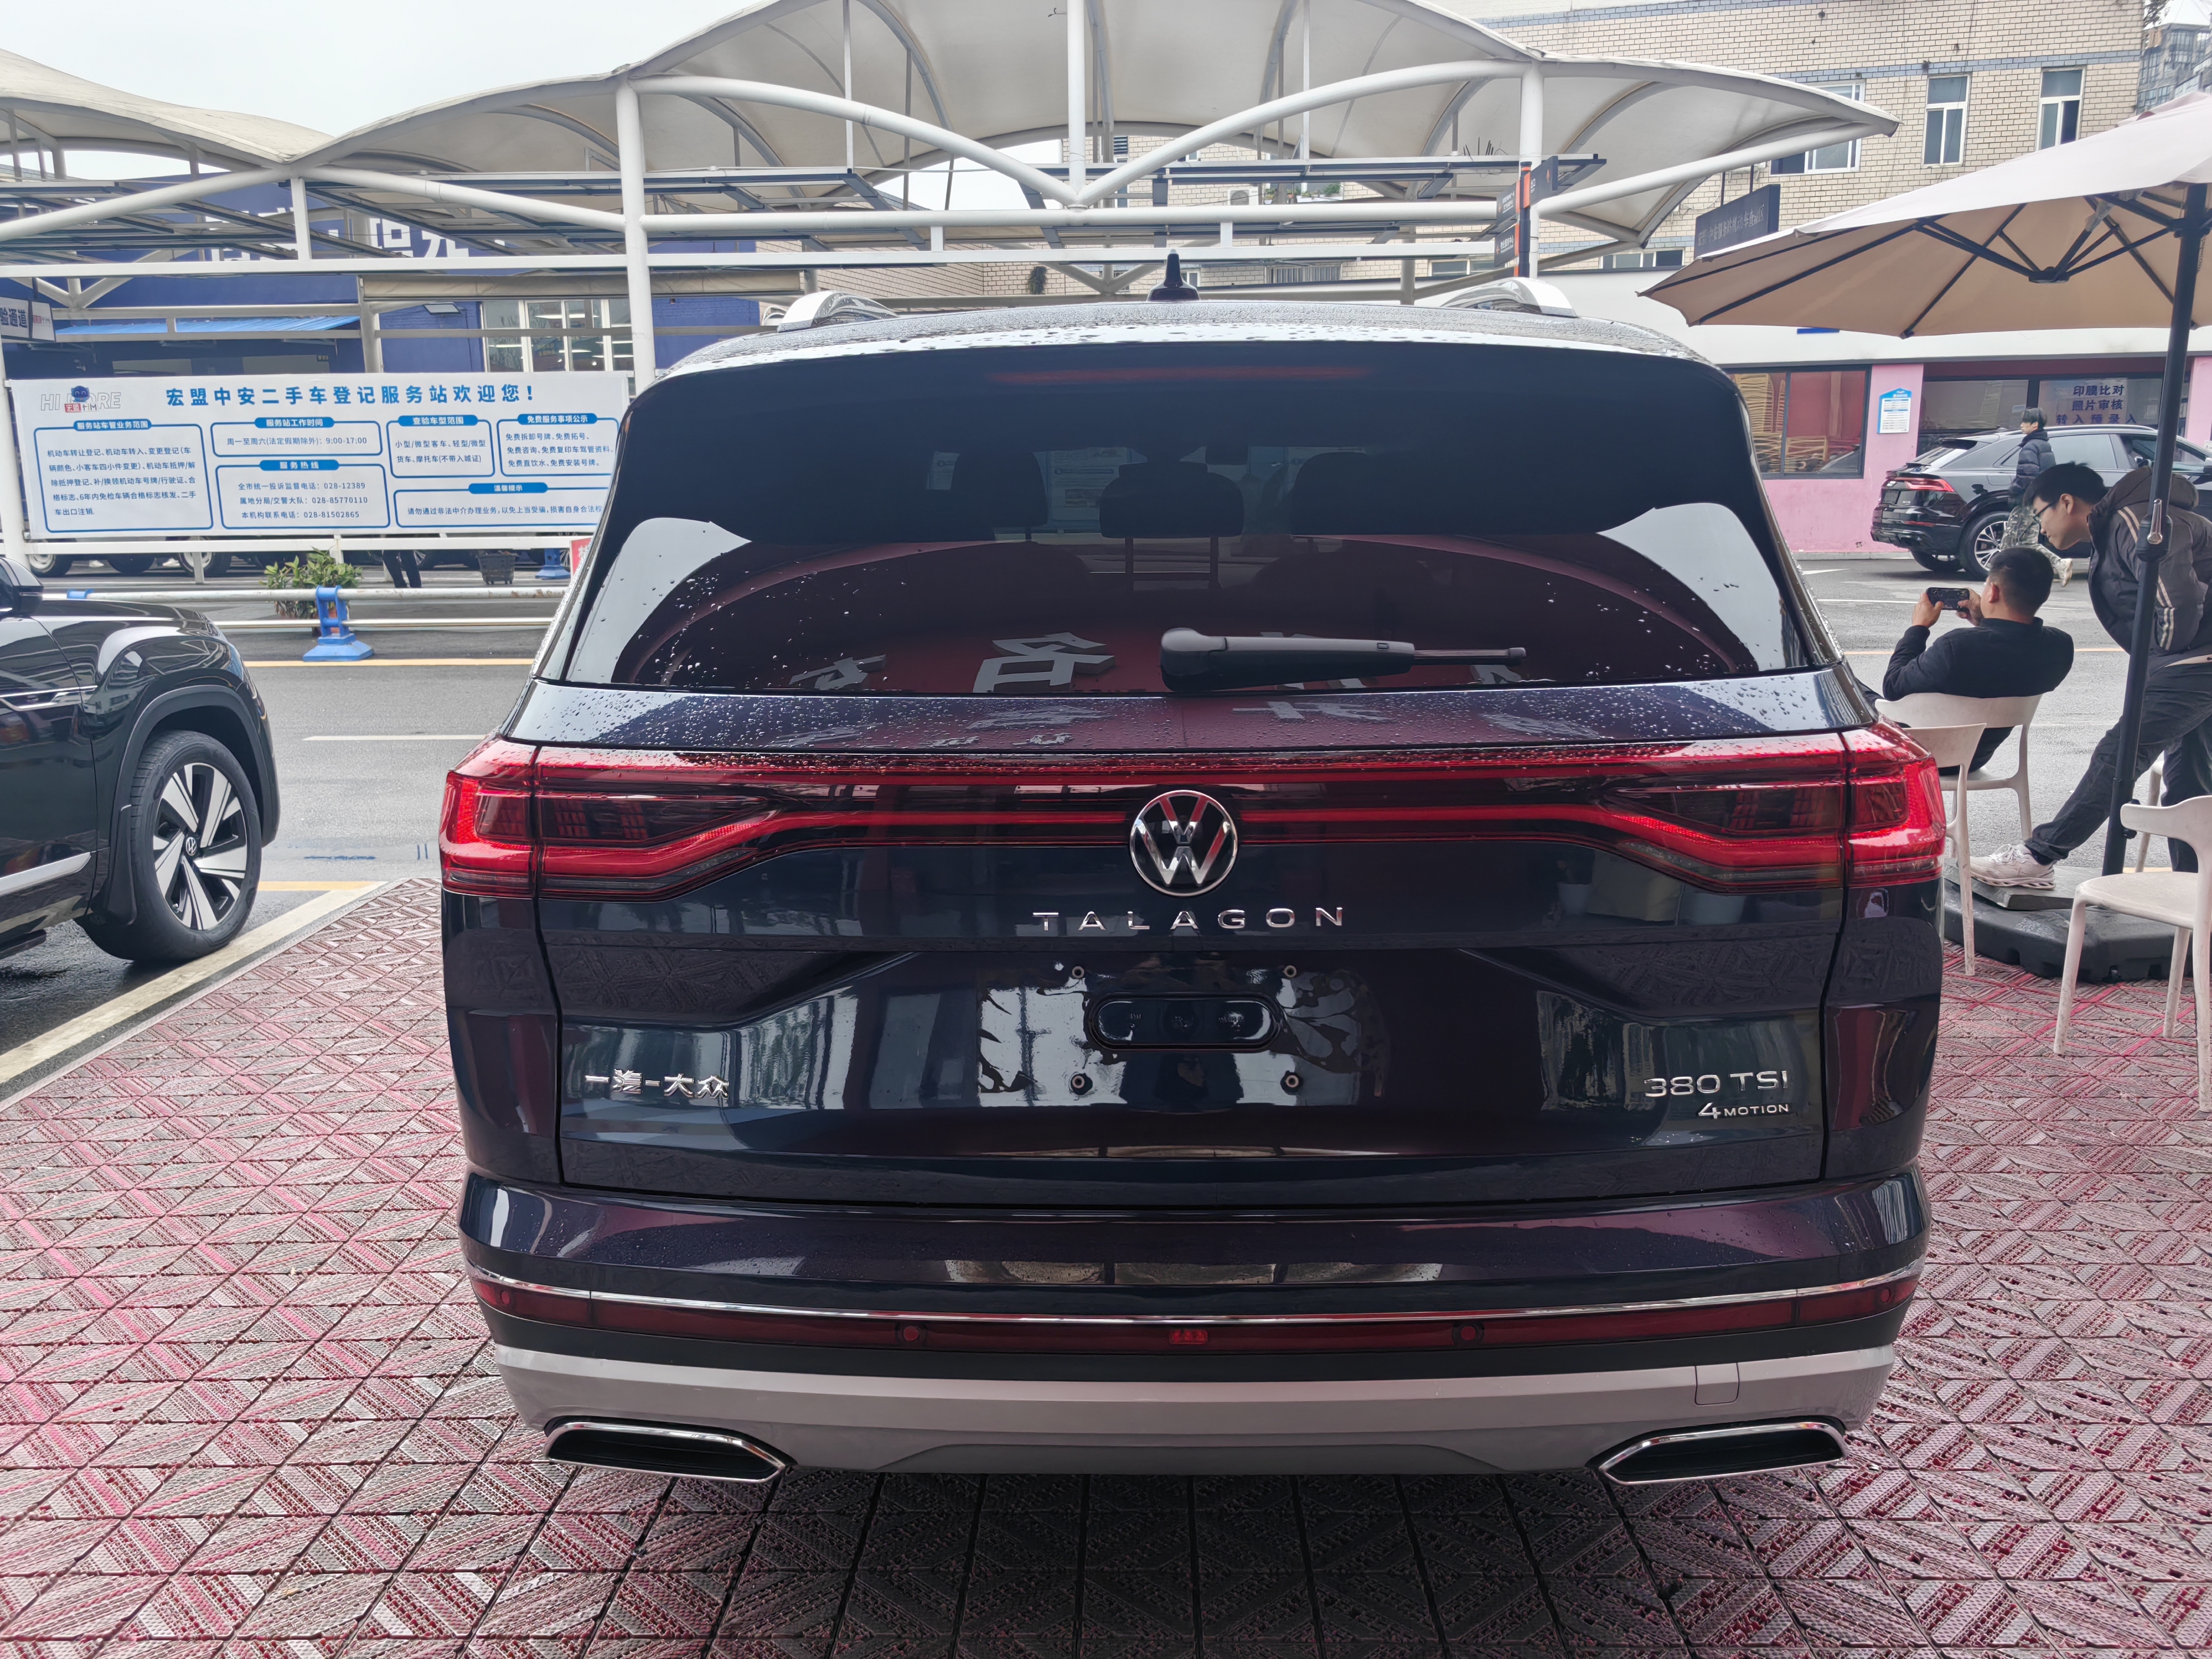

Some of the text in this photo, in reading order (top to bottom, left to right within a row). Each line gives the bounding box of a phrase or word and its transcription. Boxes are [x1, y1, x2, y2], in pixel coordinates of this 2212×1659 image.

[77, 421, 149, 429] 服务站车管业务范围
[413, 416, 464, 425] 查验车型范围
[527, 415, 588, 423] 免费服务事项公示
[1033, 907, 1344, 931] TALAGON
[1644, 1070, 1788, 1097] 380 TSI
[1697, 1102, 1789, 1119] 4MOTION
